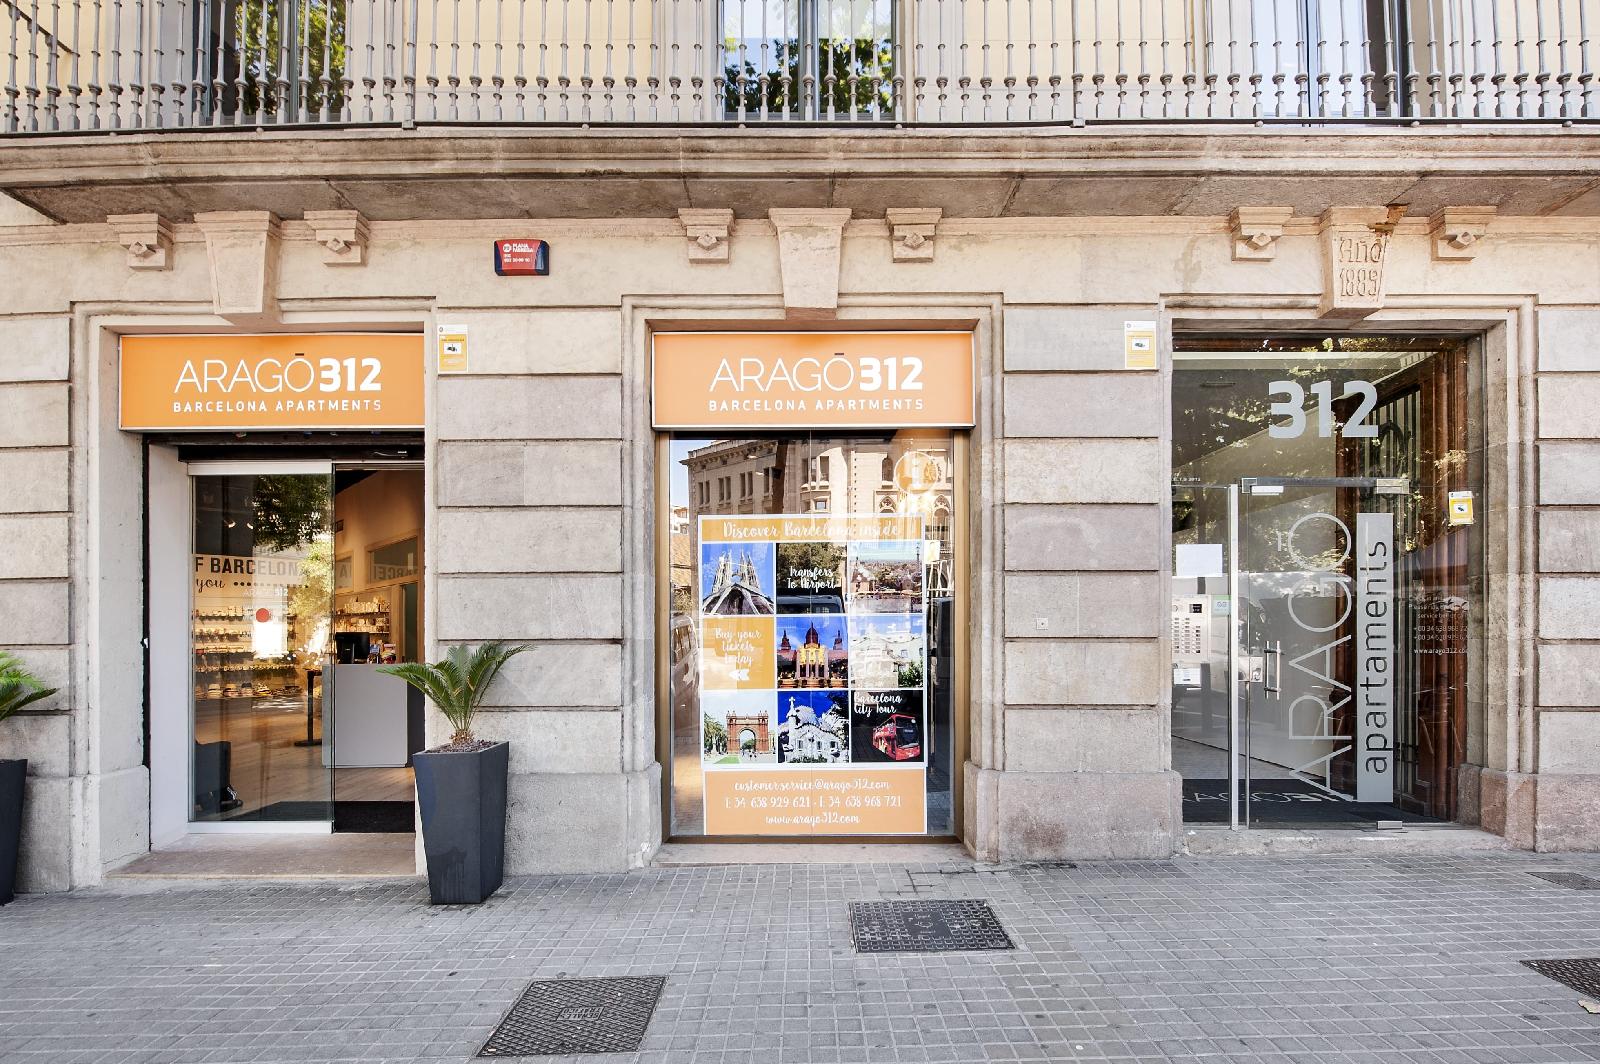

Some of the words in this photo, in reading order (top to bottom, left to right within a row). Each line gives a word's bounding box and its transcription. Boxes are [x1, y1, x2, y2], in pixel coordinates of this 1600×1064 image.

[319, 357, 382, 393] 312
[859, 356, 923, 391] 312
[173, 400, 267, 413] BARCELONA
[275, 399, 382, 412] APARTMENTS
[708, 399, 806, 412] BARCELONA
[815, 398, 924, 411] APARTMENTS
[1268, 380, 1379, 439] 312
[722, 521, 779, 539] Discover
[783, 519, 853, 538] Barcelona
[210, 557, 304, 577] BARCELON
[789, 565, 834, 583] Transfers
[196, 578, 226, 593] you
[786, 577, 798, 589] To
[800, 576, 836, 593] Airport
[715, 628, 733, 643] Buy
[737, 629, 763, 643] your
[1360, 541, 1393, 774] apartaments
[853, 691, 902, 704] Barcelona
[853, 702, 873, 718] City
[876, 702, 897, 714] Tour
[770, 796, 789, 809] 929
[792, 796, 810, 808] 621
[828, 796, 841, 808] 34
[883, 795, 901, 807] 721
[765, 811, 861, 828] www.arago312.com
